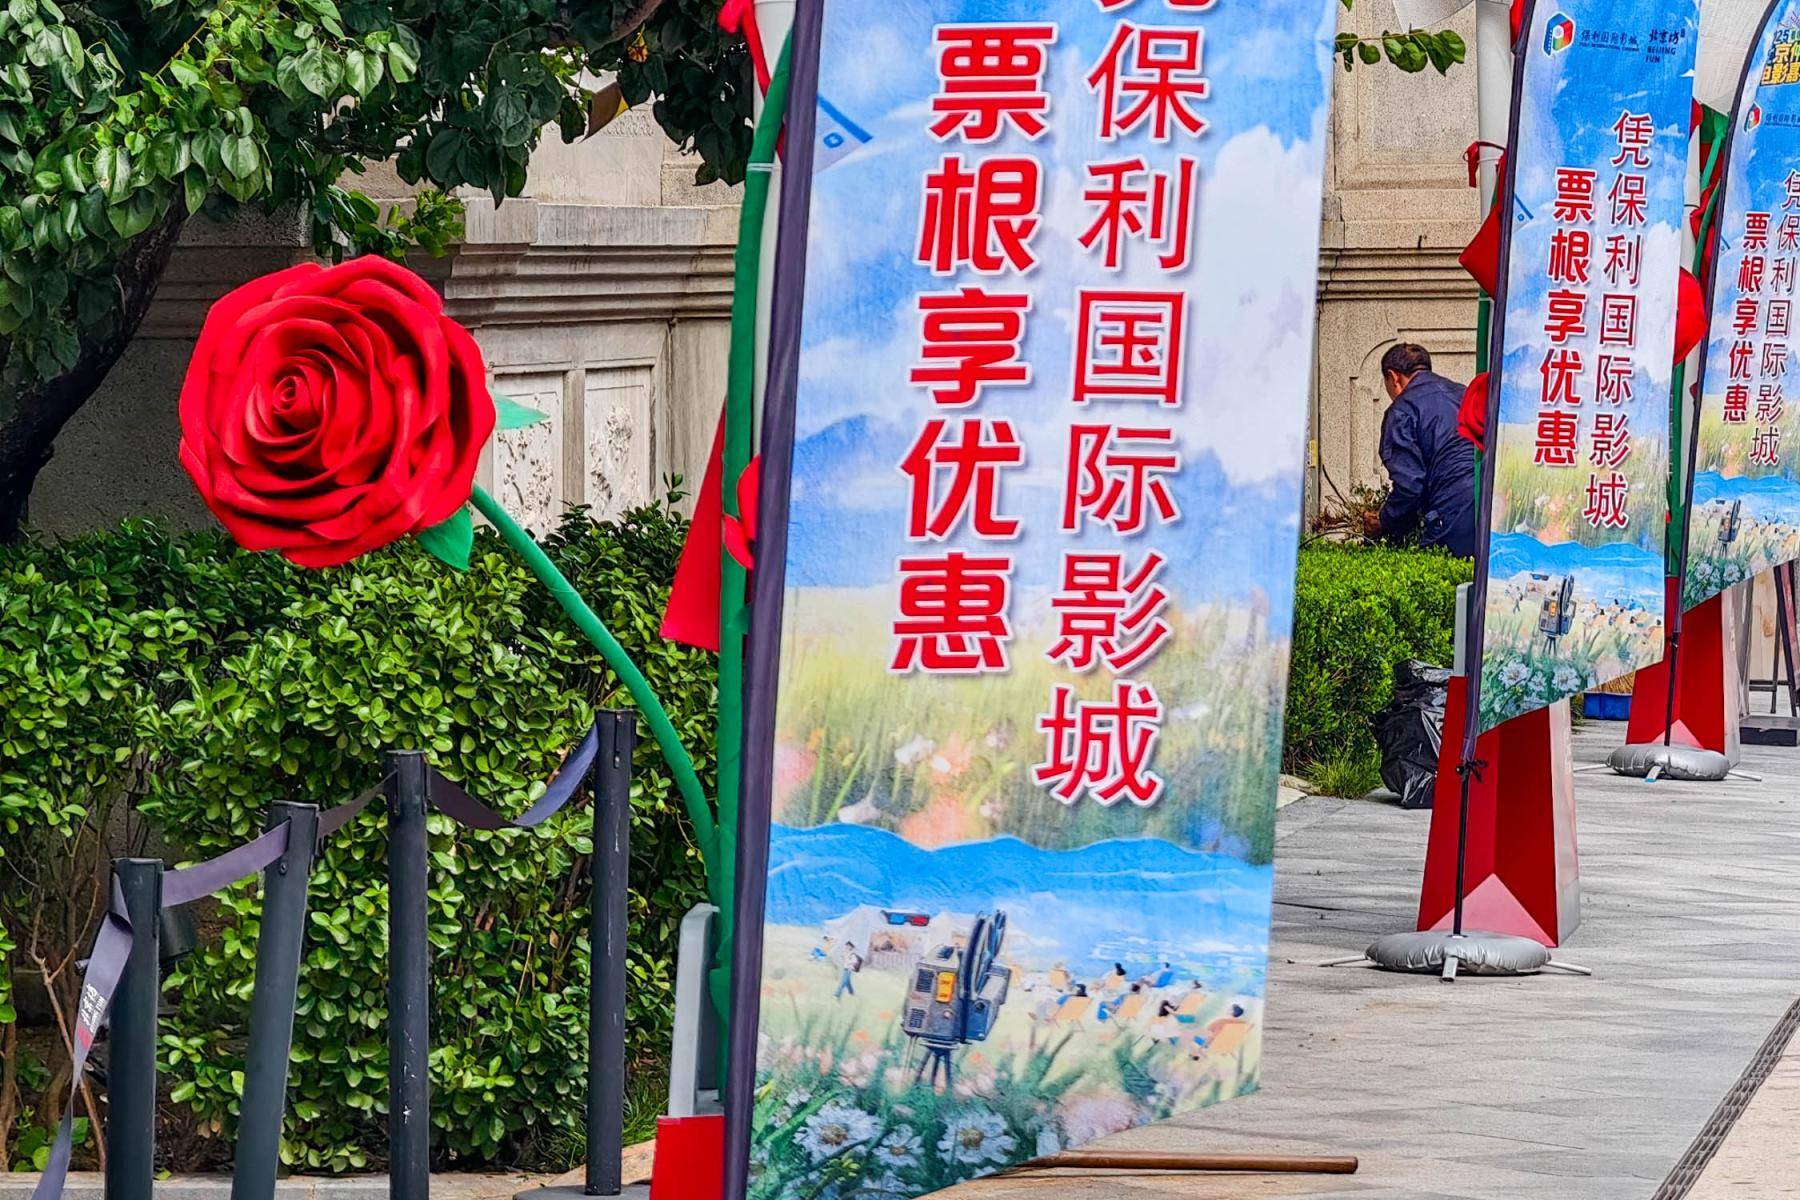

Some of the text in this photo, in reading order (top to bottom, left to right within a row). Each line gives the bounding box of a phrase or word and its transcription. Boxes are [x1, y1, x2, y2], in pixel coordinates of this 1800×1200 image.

[890, 26, 1054, 672] 票根享优惠
[1534, 169, 1597, 467] 票根享优惠
[1584, 112, 1654, 528] 凭保利国际影城
[1722, 212, 1771, 423] 票根享优惠
